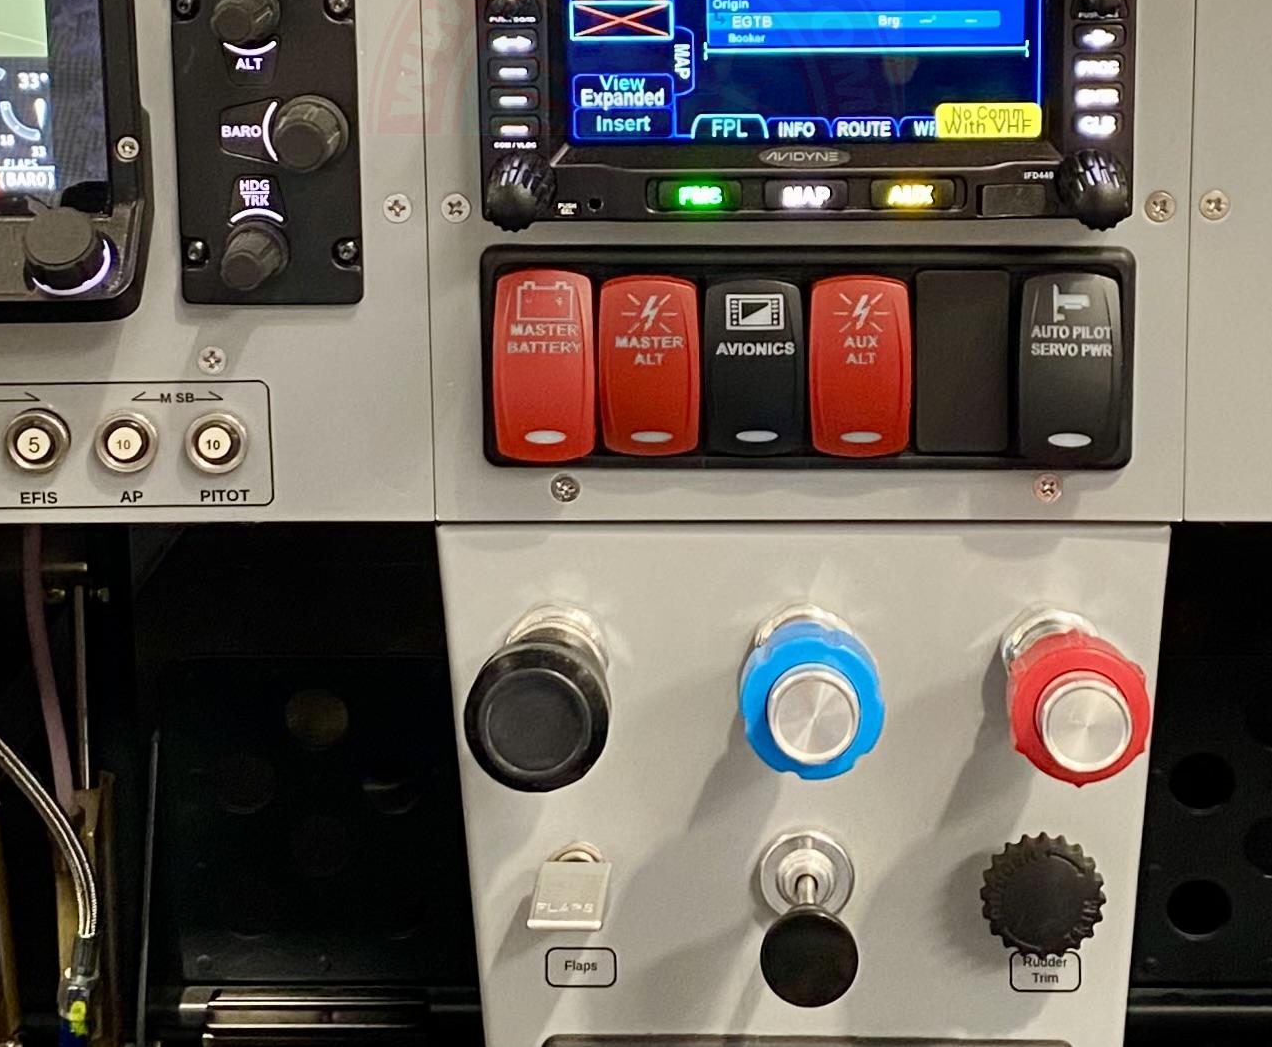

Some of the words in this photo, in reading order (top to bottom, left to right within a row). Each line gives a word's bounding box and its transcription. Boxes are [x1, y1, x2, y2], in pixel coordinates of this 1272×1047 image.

[712, 0, 749, 10] Origin
[732, 16, 772, 28] EGTB
[236, 57, 263, 70] ALT
[674, 43, 690, 79] MAP
[599, 75, 645, 90] View
[581, 89, 665, 110] Expanded
[596, 115, 651, 132] Insert
[711, 119, 748, 137] FPL
[837, 121, 891, 137] ROUTE
[944, 119, 986, 134] With
[989, 119, 1032, 134] VHF
[510, 323, 579, 337] MASTER
[1030, 324, 1070, 339] AUTO
[1073, 325, 1112, 339] PILOT
[507, 341, 581, 354] BATTERY
[615, 335, 684, 349] MASTER
[843, 335, 878, 349] AUX
[716, 342, 795, 357] AVIONICS
[1030, 343, 1076, 357] SERVO
[1078, 344, 1113, 357] PWR
[634, 353, 665, 366] ALT
[846, 353, 876, 366] ALT
[20, 492, 58, 504] EFIS
[120, 491, 144, 503] AP
[201, 490, 250, 502] PITOT
[564, 959, 598, 974] Flaps
[1031, 972, 1059, 984] Trim
